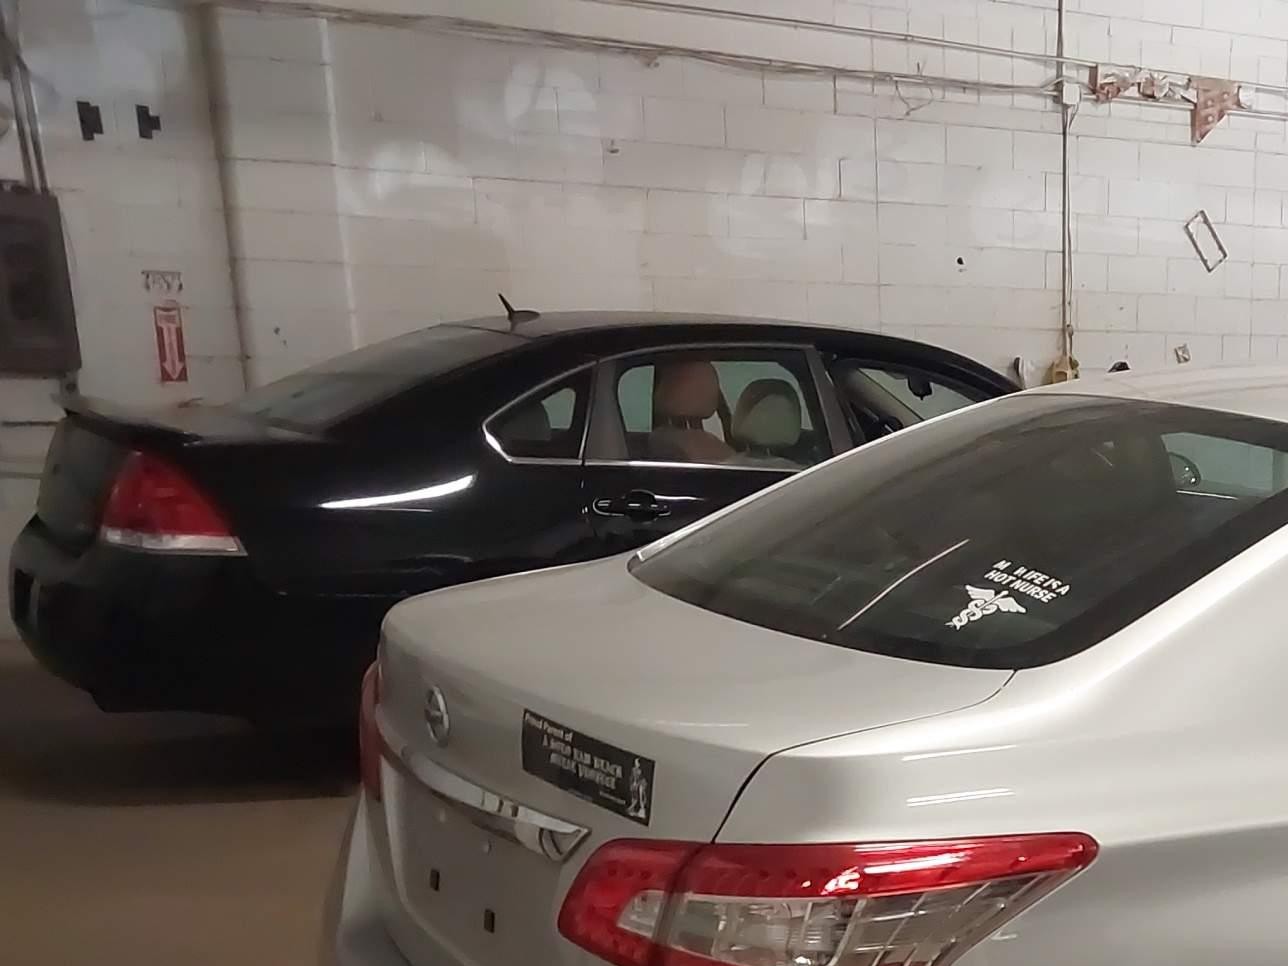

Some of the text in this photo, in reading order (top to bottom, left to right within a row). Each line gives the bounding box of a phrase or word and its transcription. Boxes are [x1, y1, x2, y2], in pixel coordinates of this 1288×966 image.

[984, 570, 1057, 603] HOT NURSE
[1055, 585, 1070, 595] A
